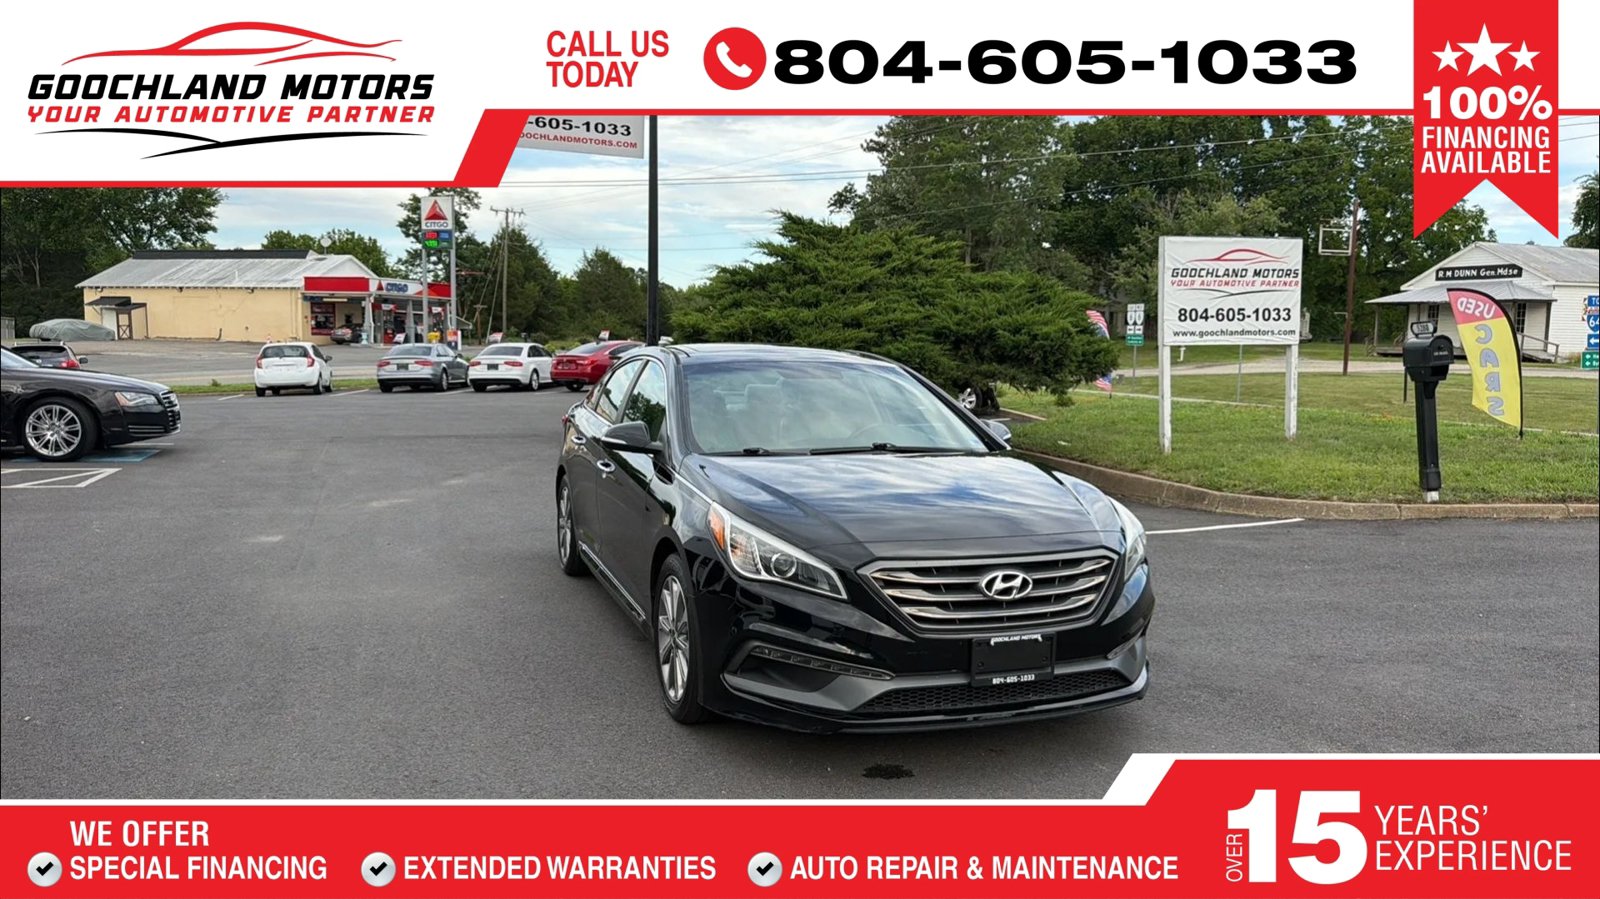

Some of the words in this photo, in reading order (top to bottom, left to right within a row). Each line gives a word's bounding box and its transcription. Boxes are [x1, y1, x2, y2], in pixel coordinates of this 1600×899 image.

[1171, 268, 1249, 278] GOOCHLAND
[1252, 268, 1300, 279] MOTORS
[1454, 269, 1478, 277] DUNN
[385, 282, 409, 293] CITGO
[1178, 307, 1291, 322] 804-605-1033
[1173, 329, 1296, 338] www.goochlandmotors.com
[992, 674, 1035, 684] 804-605-1033
